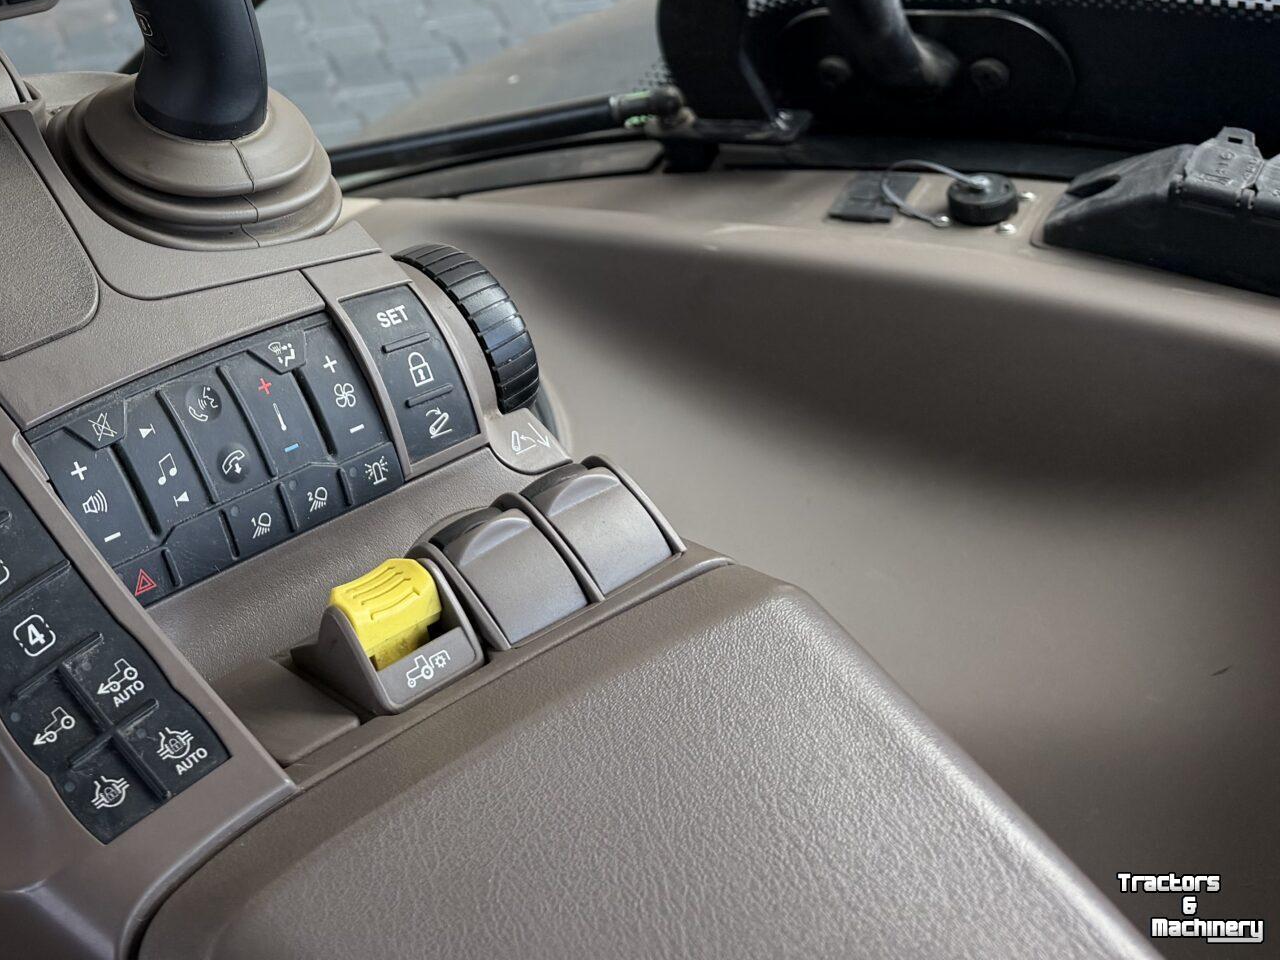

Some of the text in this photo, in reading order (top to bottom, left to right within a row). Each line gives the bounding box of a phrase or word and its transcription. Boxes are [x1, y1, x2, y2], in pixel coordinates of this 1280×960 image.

[376, 304, 409, 329] SET
[307, 491, 314, 502] 2
[251, 517, 257, 527] 1
[24, 625, 45, 647] 4
[113, 679, 145, 707] AUTO
[176, 746, 208, 775] AUTO
